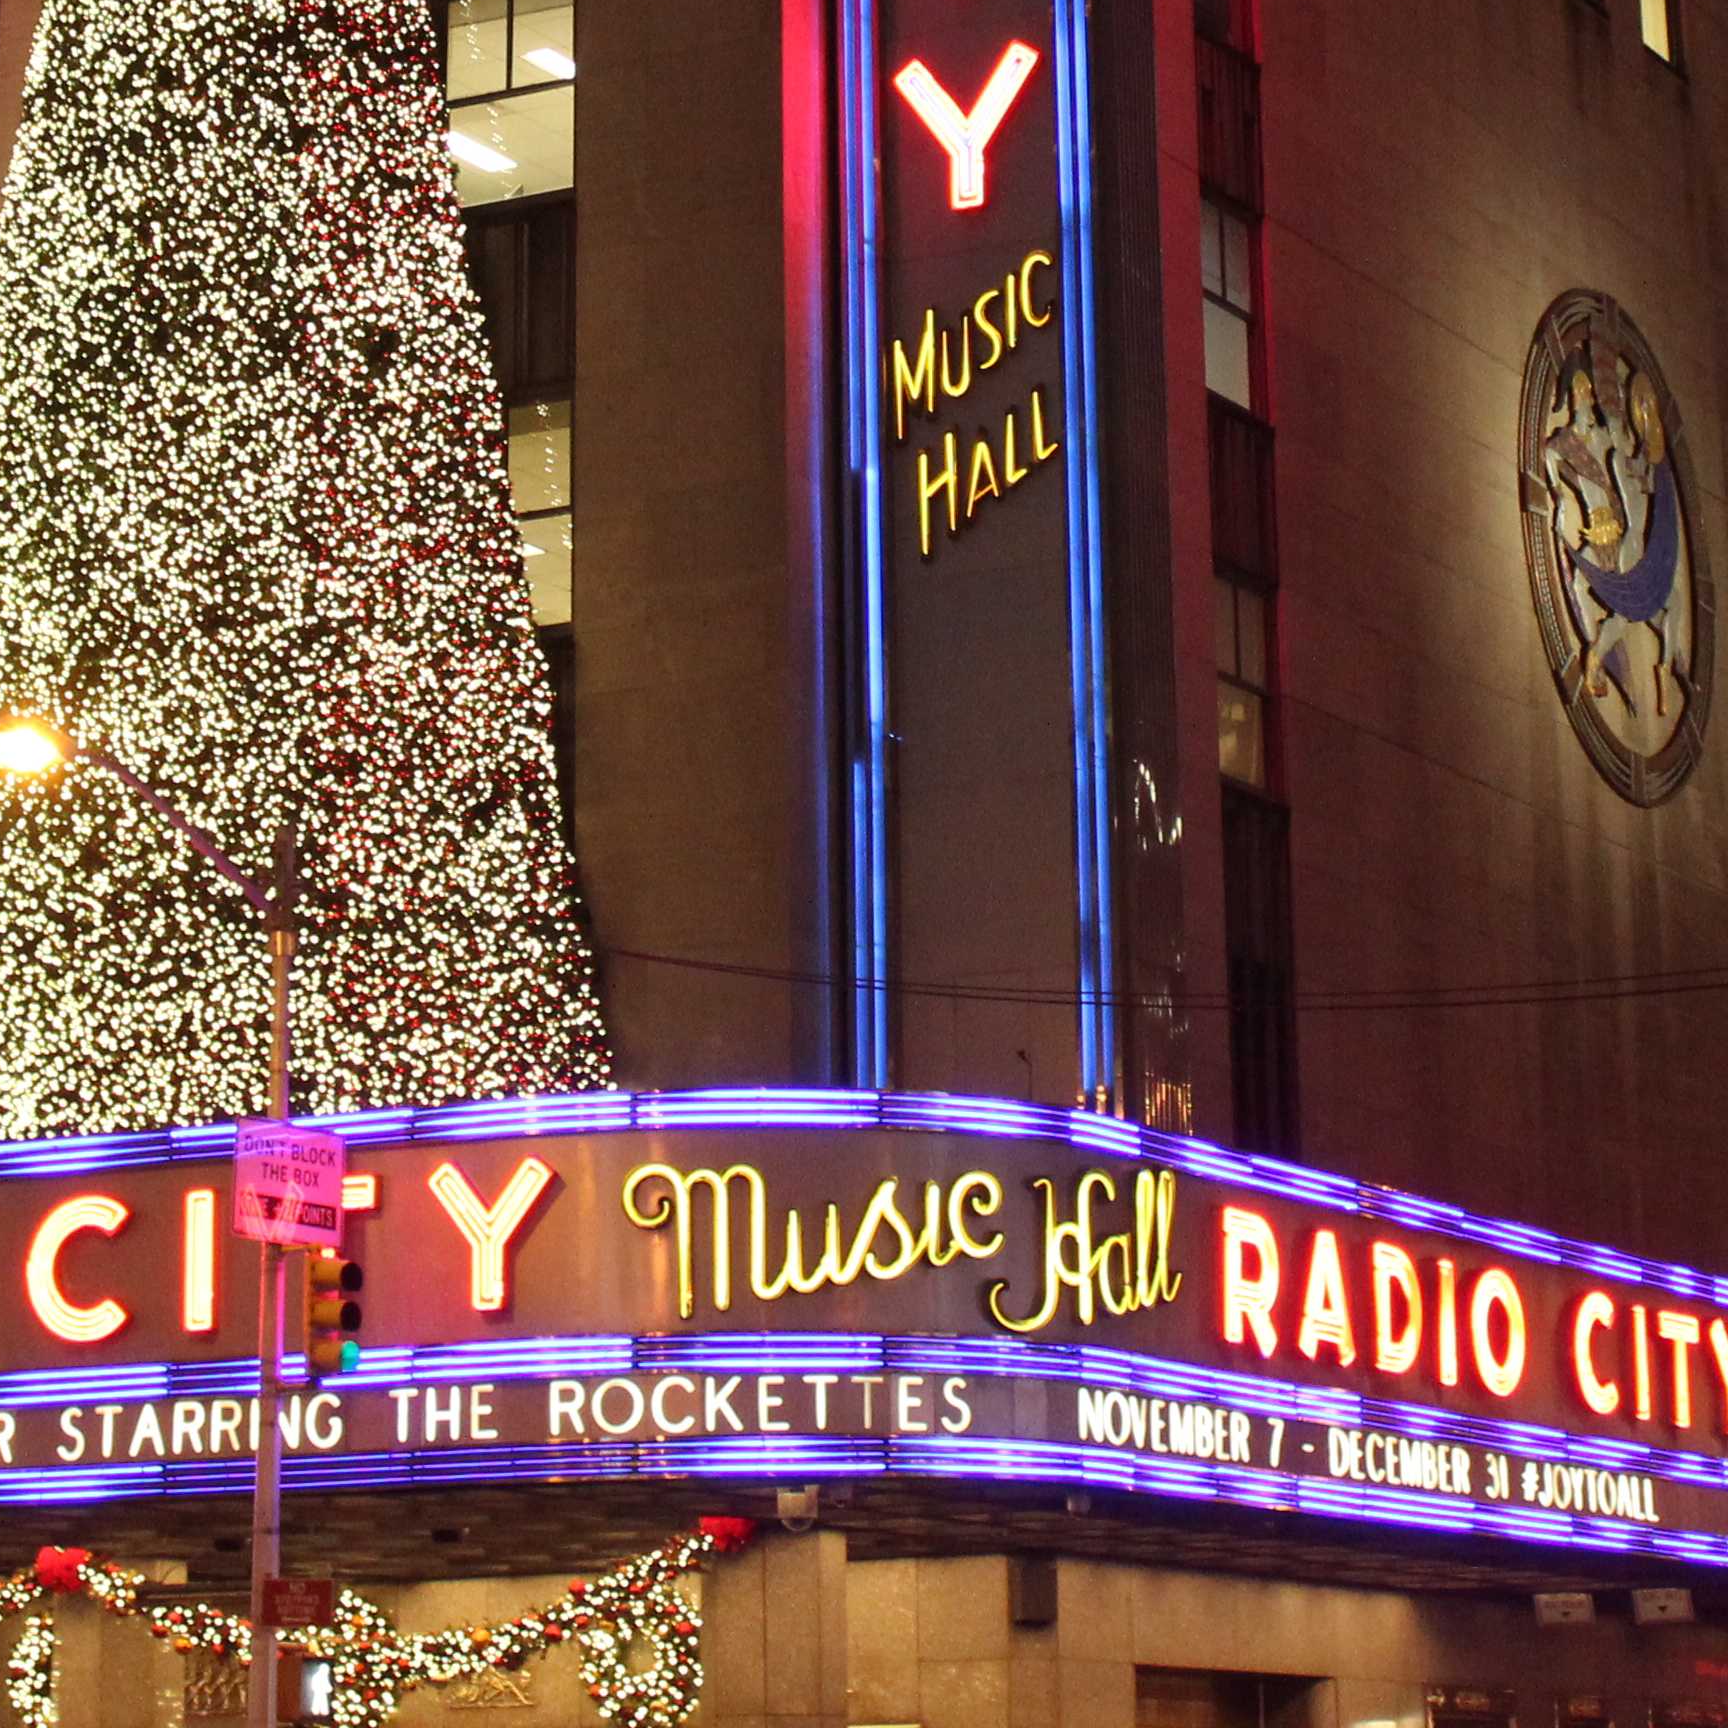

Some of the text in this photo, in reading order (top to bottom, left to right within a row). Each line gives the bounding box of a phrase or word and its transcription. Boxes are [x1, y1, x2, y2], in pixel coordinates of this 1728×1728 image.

[893, 251, 1054, 439] MUSIC
[916, 388, 1058, 558] HALL
[261, 1162, 320, 1187] THE BOX
[291, 1144, 336, 1168] BLOCK
[26, 1156, 554, 1342] CIY
[624, 1162, 1004, 1319] Music
[991, 1169, 1181, 1332] Hall
[1221, 1203, 1528, 1398] RADIO
[56, 1392, 344, 1462] STARRING
[388, 1383, 499, 1443] THE
[548, 1374, 973, 1434] ROCKETTES
[1077, 1386, 1251, 1465] NOVEMBER
[1268, 1418, 1284, 1467] 7
[1328, 1427, 1473, 1494] DECEMBER
[1485, 1453, 1510, 1500] 31
[1522, 1461, 1660, 1523] #JOYTOALL
